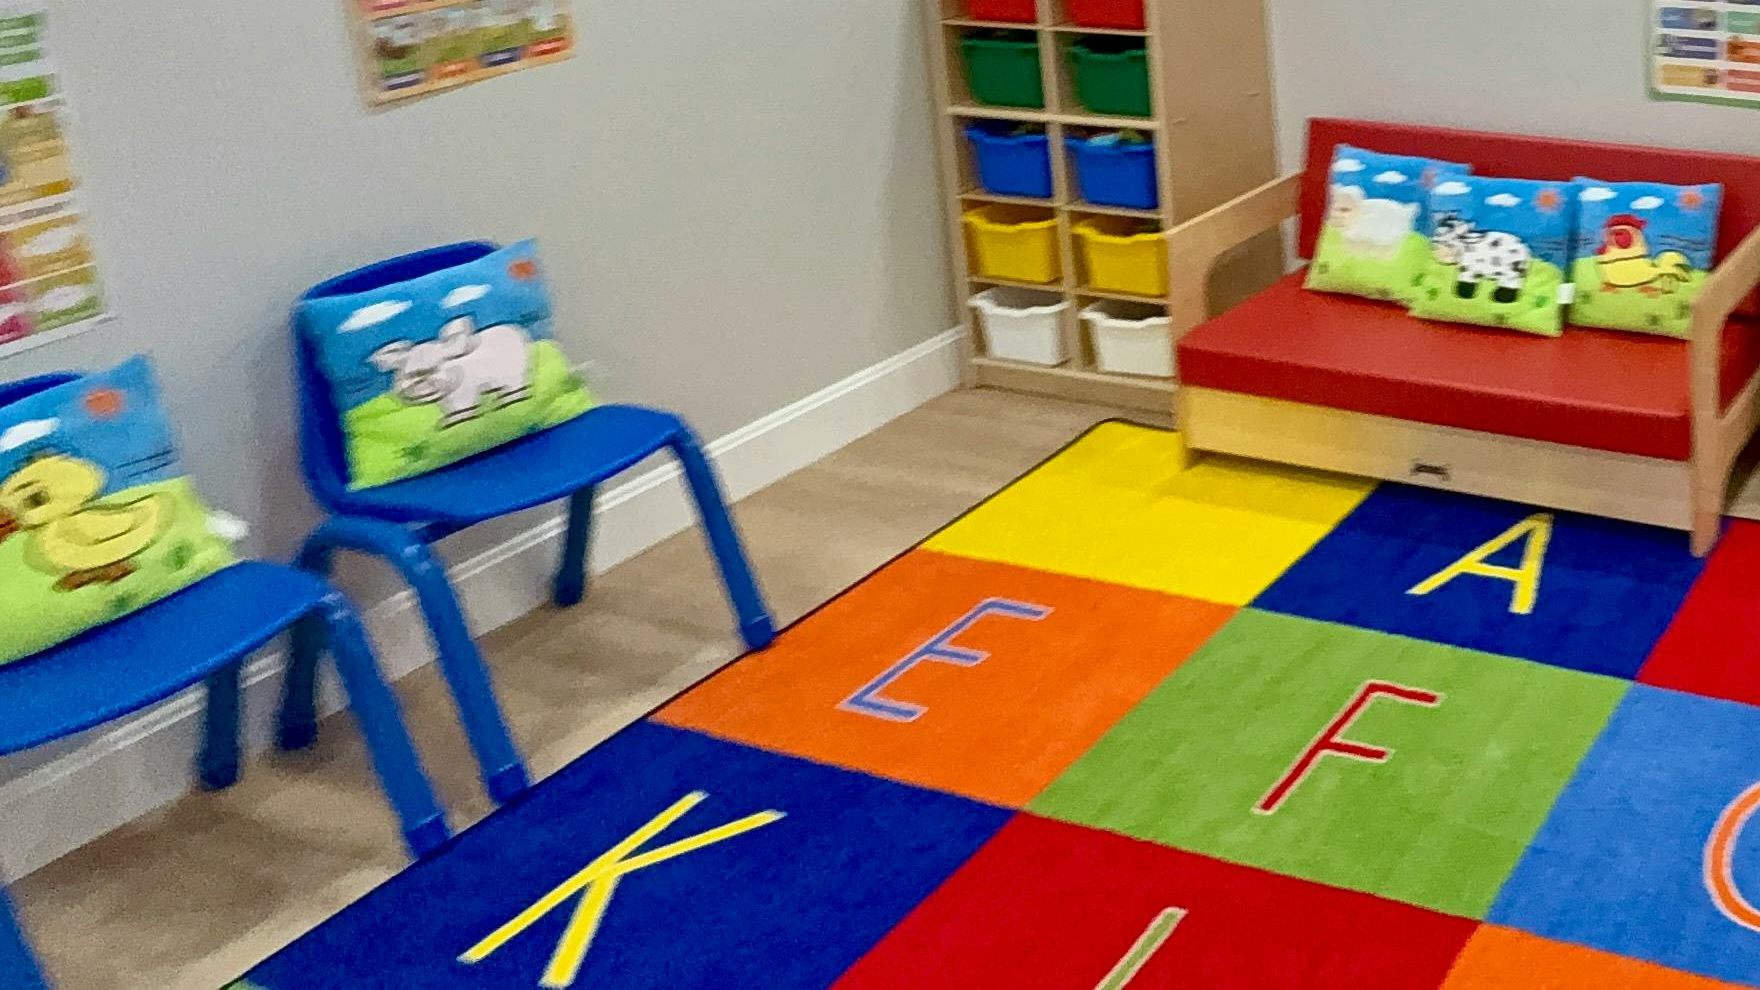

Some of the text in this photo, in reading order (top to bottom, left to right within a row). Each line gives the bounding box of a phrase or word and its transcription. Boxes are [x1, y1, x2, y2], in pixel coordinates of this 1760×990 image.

[1404, 512, 1556, 615] A
[834, 596, 1056, 723] E
[1250, 679, 1448, 816] F
[455, 789, 788, 989] K
